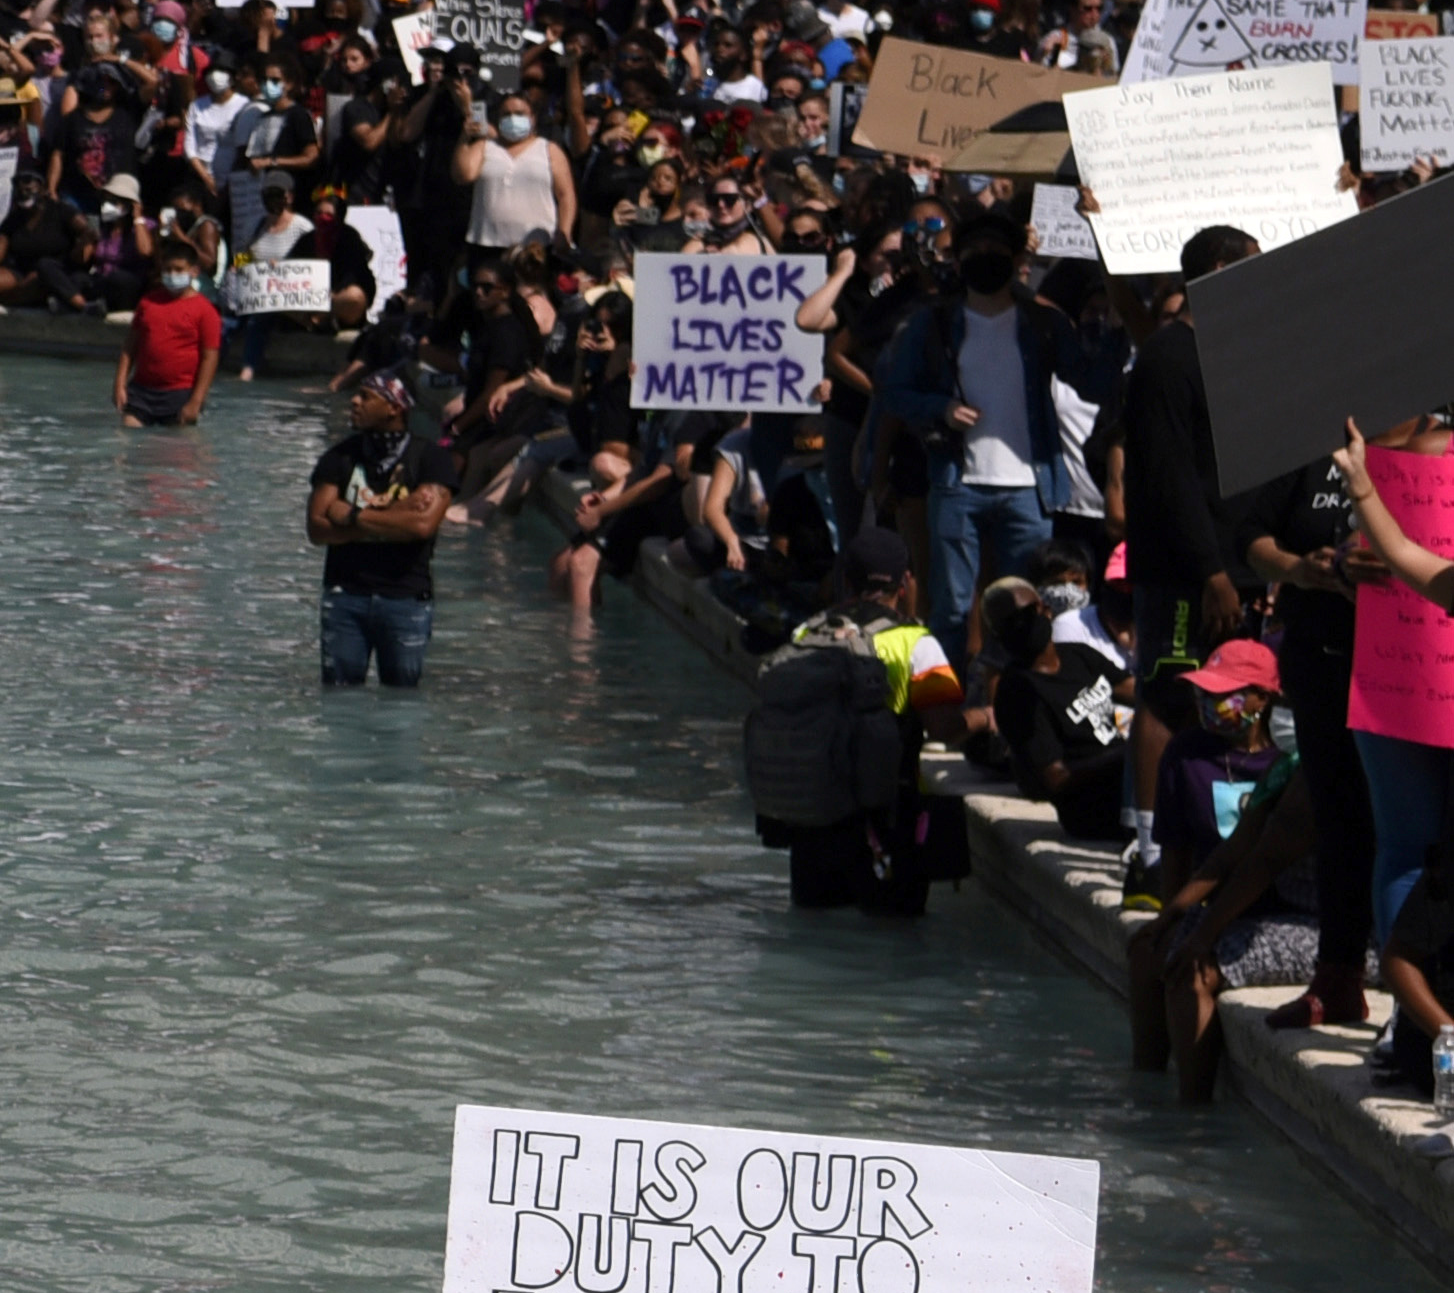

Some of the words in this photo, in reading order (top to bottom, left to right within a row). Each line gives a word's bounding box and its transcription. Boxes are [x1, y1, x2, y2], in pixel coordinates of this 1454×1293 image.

[1302, 0, 1357, 18] THAT
[431, 12, 524, 51] EQUALS
[1249, 19, 1313, 39] BURN
[1261, 33, 1358, 64] CROSSES!
[906, 53, 999, 100] Black
[1386, 67, 1446, 87] LIVES
[670, 261, 807, 310] BLACK
[672, 317, 787, 351] LIVES
[643, 357, 805, 405] MATTER
[489, 1128, 581, 1211] IT
[611, 1138, 708, 1222] IS
[736, 1147, 934, 1240] OUR
